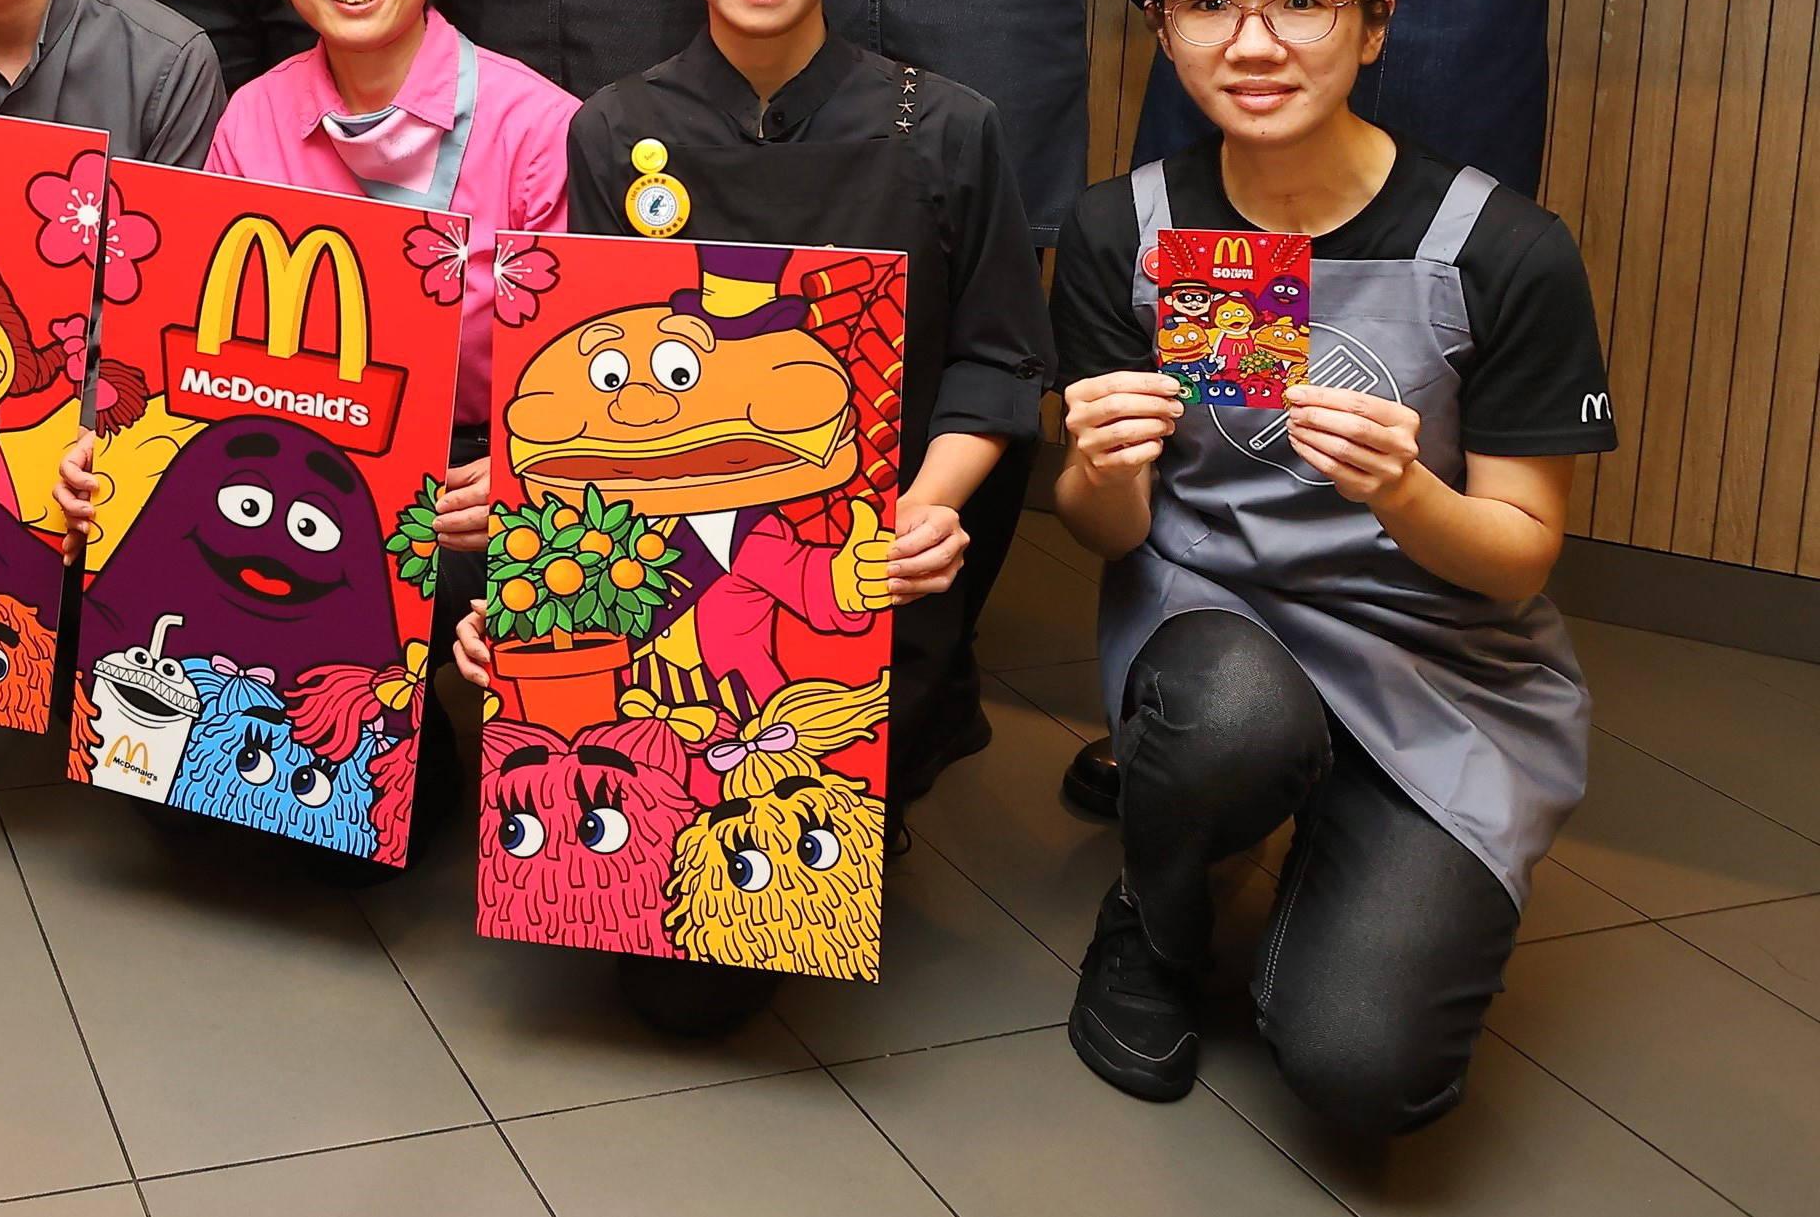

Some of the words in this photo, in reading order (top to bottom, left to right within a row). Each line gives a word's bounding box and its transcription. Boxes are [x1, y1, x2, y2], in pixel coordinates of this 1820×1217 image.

[1212, 268, 1230, 279] 50
[180, 368, 370, 427] McDonald's
[113, 756, 158, 781] McDonald's
